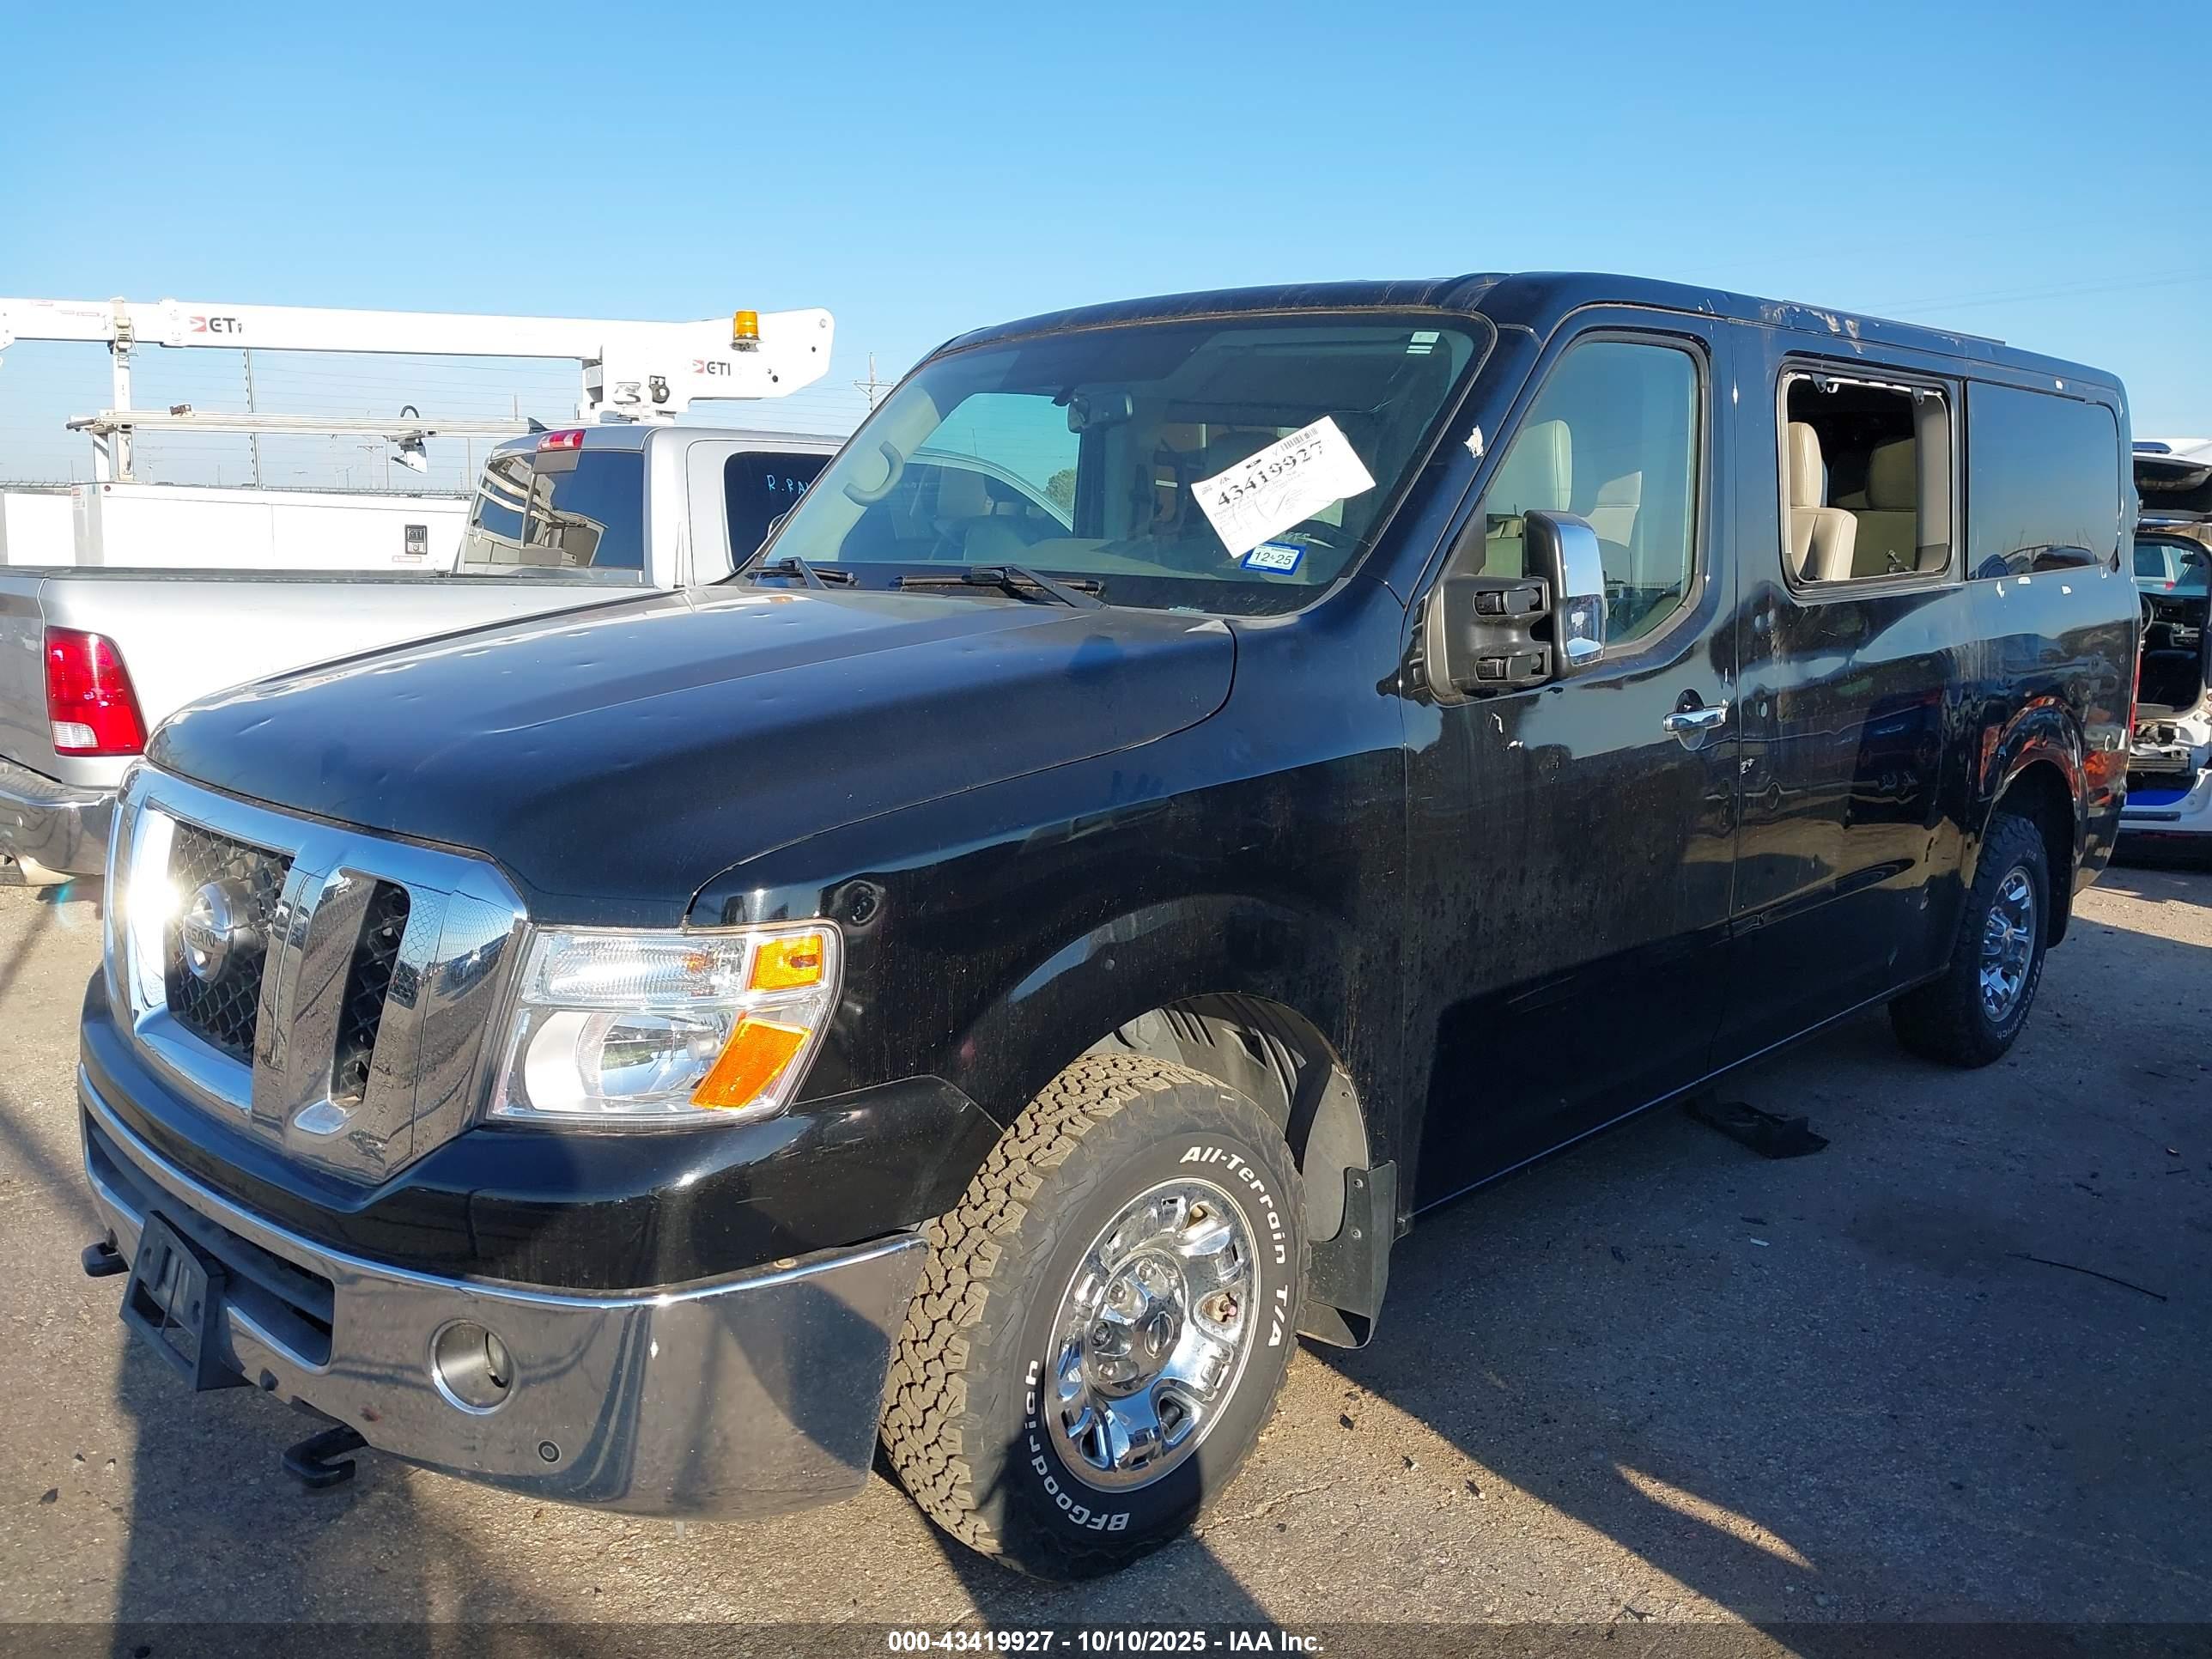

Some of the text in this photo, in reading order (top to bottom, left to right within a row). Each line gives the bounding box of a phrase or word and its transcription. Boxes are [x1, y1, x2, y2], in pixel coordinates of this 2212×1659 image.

[707, 361, 731, 376] ETI
[1218, 440, 1322, 506] 43419927
[1179, 1146, 1288, 1347] All-Terrain T/A
[1024, 1359, 1130, 1531] BFGoodrich
